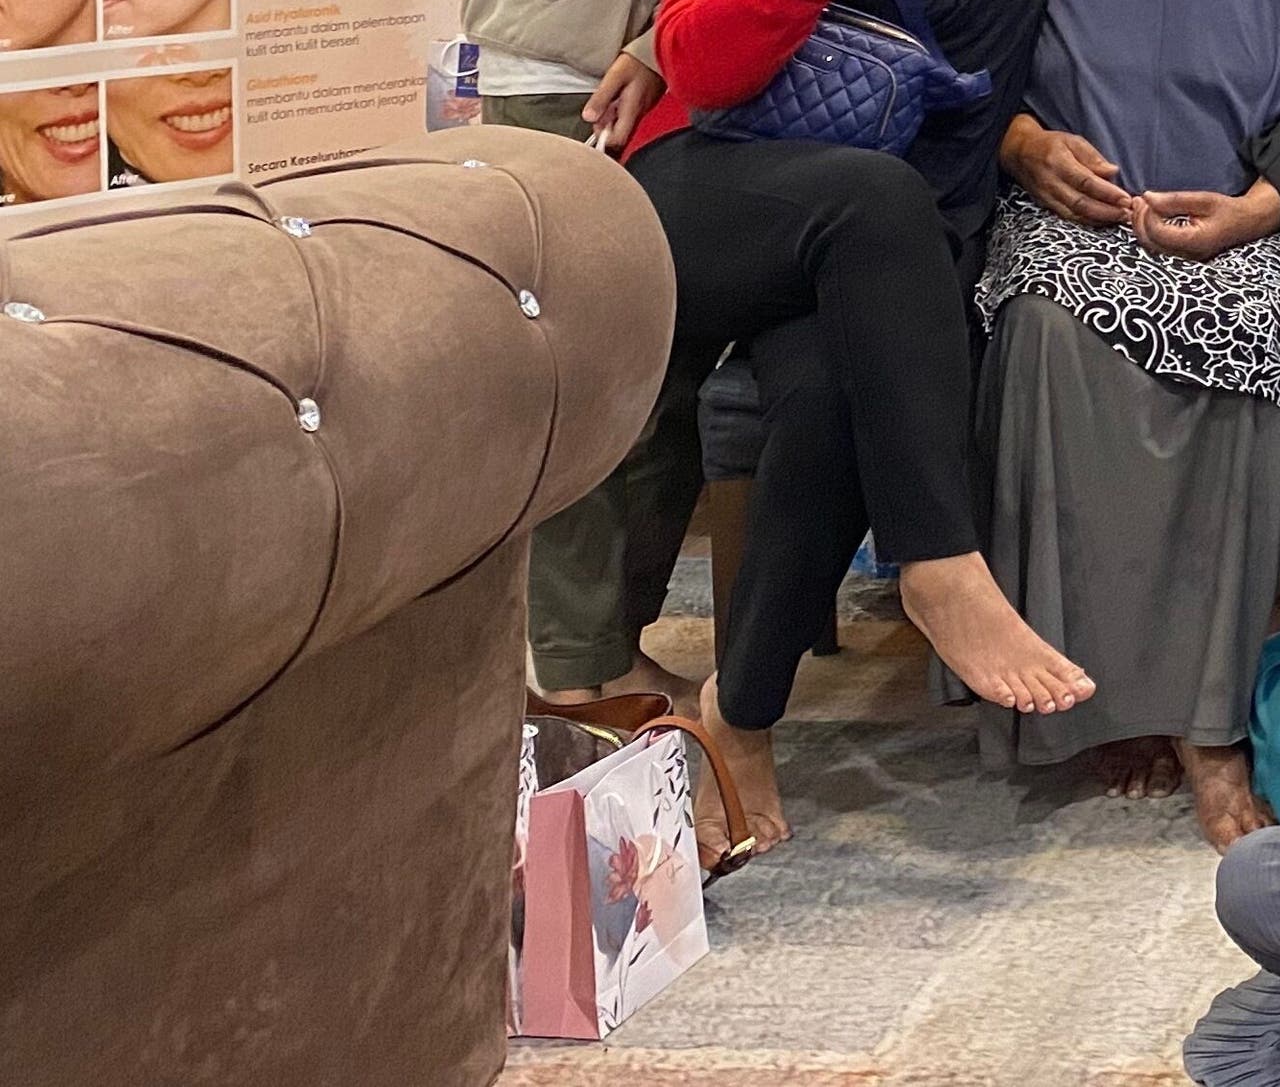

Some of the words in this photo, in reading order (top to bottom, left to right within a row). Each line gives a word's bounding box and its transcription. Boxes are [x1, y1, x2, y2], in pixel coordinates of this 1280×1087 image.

[245, 27, 308, 41] membantu
[311, 22, 350, 34] dalam
[246, 44, 267, 57] kulit
[270, 42, 293, 54] dan
[295, 38, 318, 51] kulit
[246, 91, 309, 107] membantu
[312, 85, 351, 99] dalam
[247, 110, 268, 124] kulit
[271, 106, 293, 121] dan
[296, 99, 375, 117] memudarkan
[248, 159, 287, 174] Secara
[111, 173, 139, 187] After
